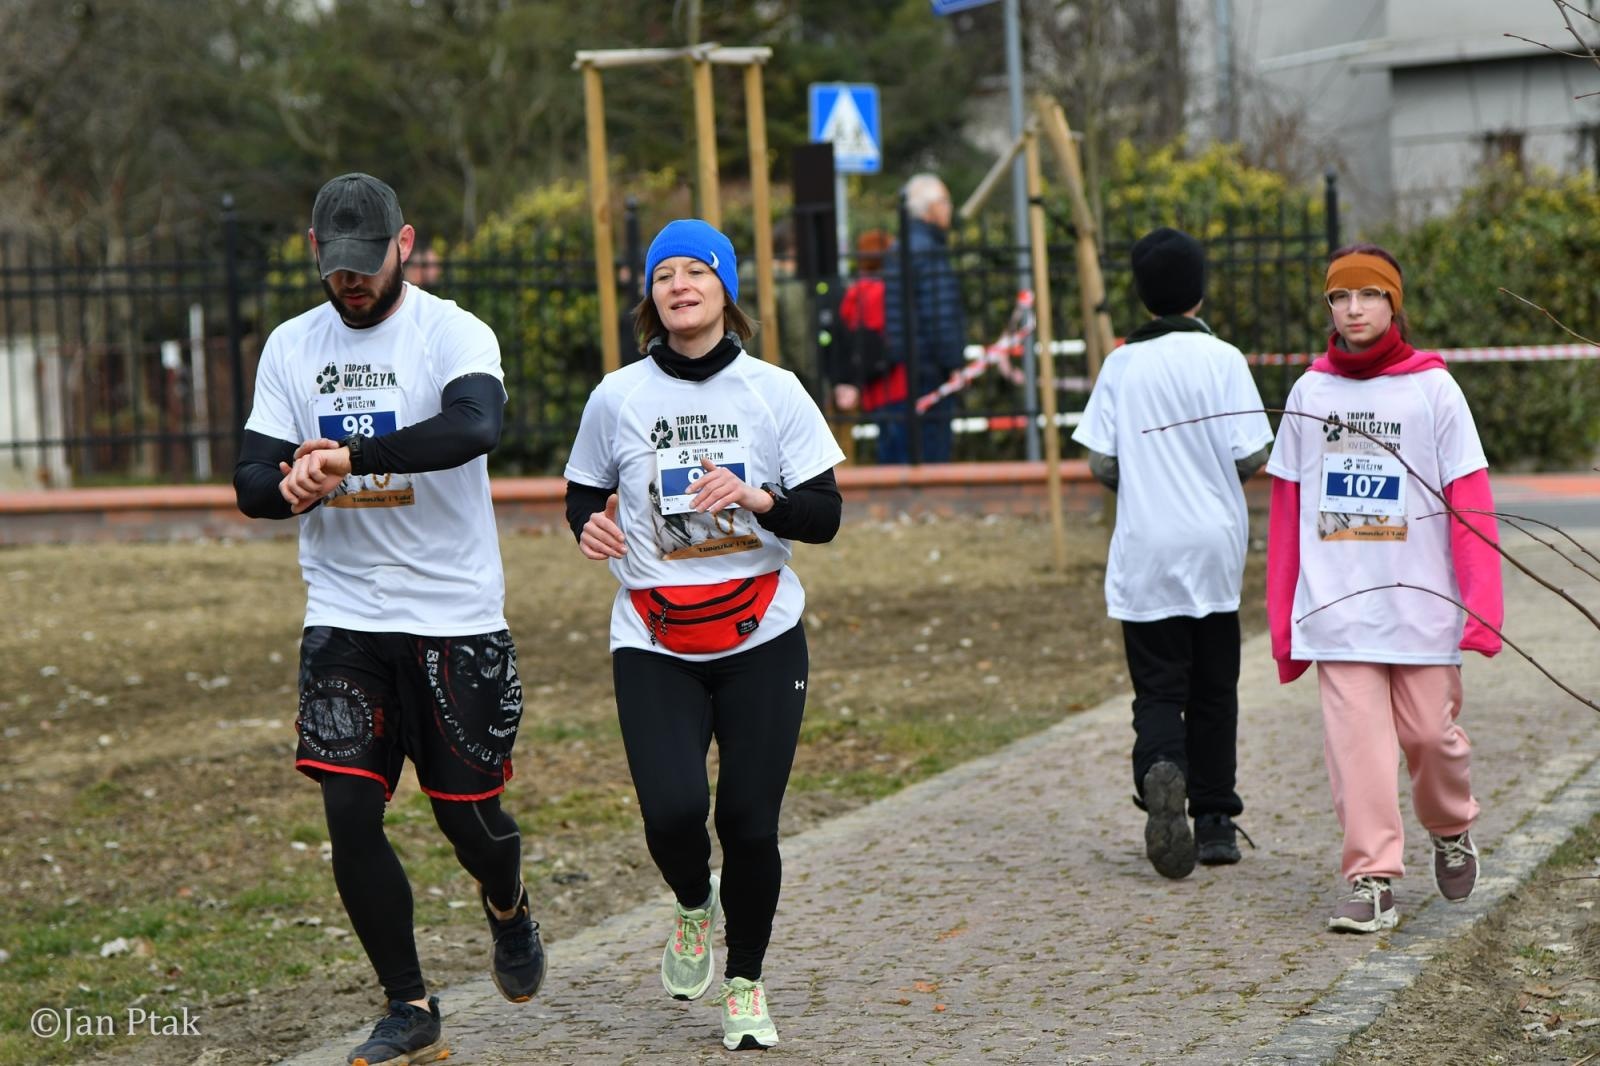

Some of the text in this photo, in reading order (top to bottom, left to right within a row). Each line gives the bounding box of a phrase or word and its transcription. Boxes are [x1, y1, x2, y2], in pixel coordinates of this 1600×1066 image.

[345, 364, 371, 373] TROPEM
[347, 400, 376, 409] WILCZYM
[676, 415, 707, 425] TROPEM
[1347, 412, 1375, 420] TROPEM
[342, 414, 375, 438] 98
[1347, 421, 1401, 436] WILCZYM
[677, 424, 739, 441] WILCZYM
[693, 452, 724, 462] WILCZYM
[1343, 475, 1387, 498] 107
